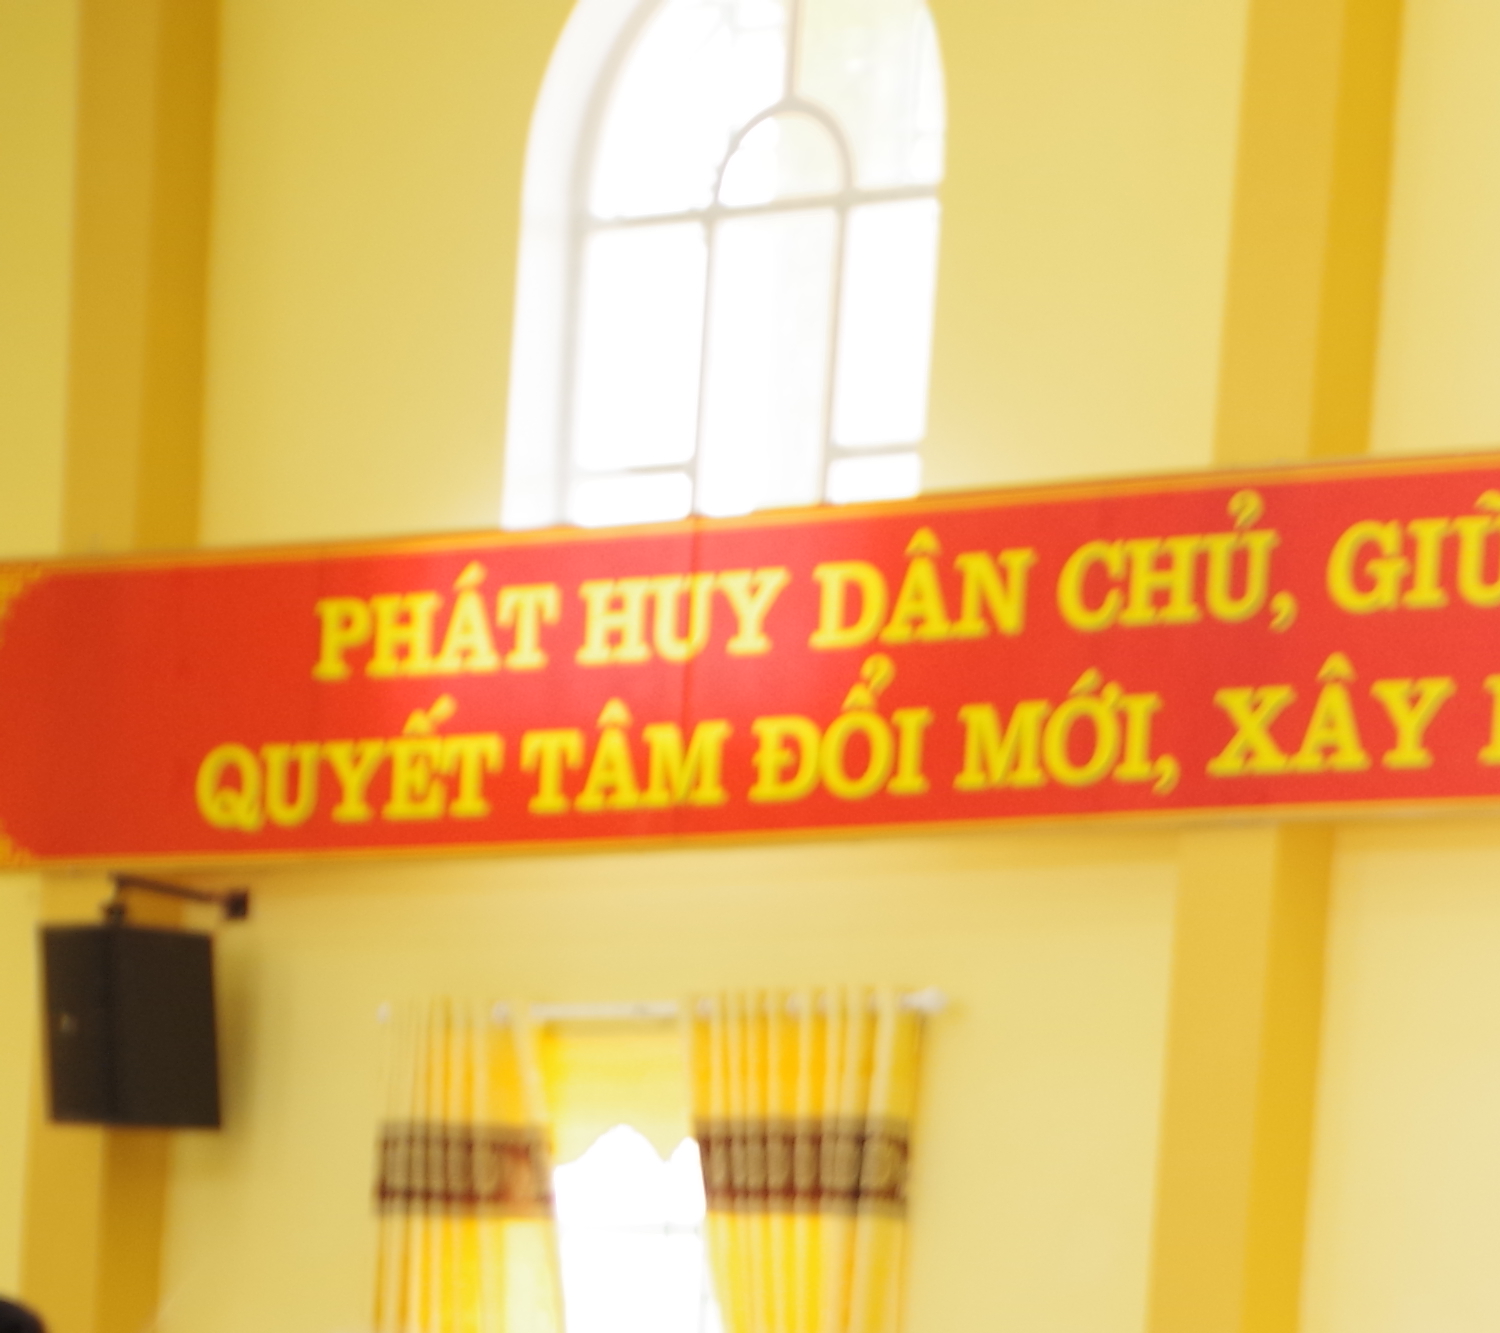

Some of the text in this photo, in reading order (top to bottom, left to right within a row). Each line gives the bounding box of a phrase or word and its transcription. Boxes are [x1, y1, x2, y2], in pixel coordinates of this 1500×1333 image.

[315, 560, 564, 681] PHÁT
[574, 565, 791, 668] HUY
[810, 527, 1033, 650] DÂN
[1057, 490, 1297, 632] CHỦ,
[197, 694, 504, 831] QUYẾT
[519, 696, 733, 815] TÂM
[748, 654, 933, 802] ĐỔI
[952, 667, 1181, 794] MỚI,
[1205, 651, 1457, 779] XÂY
